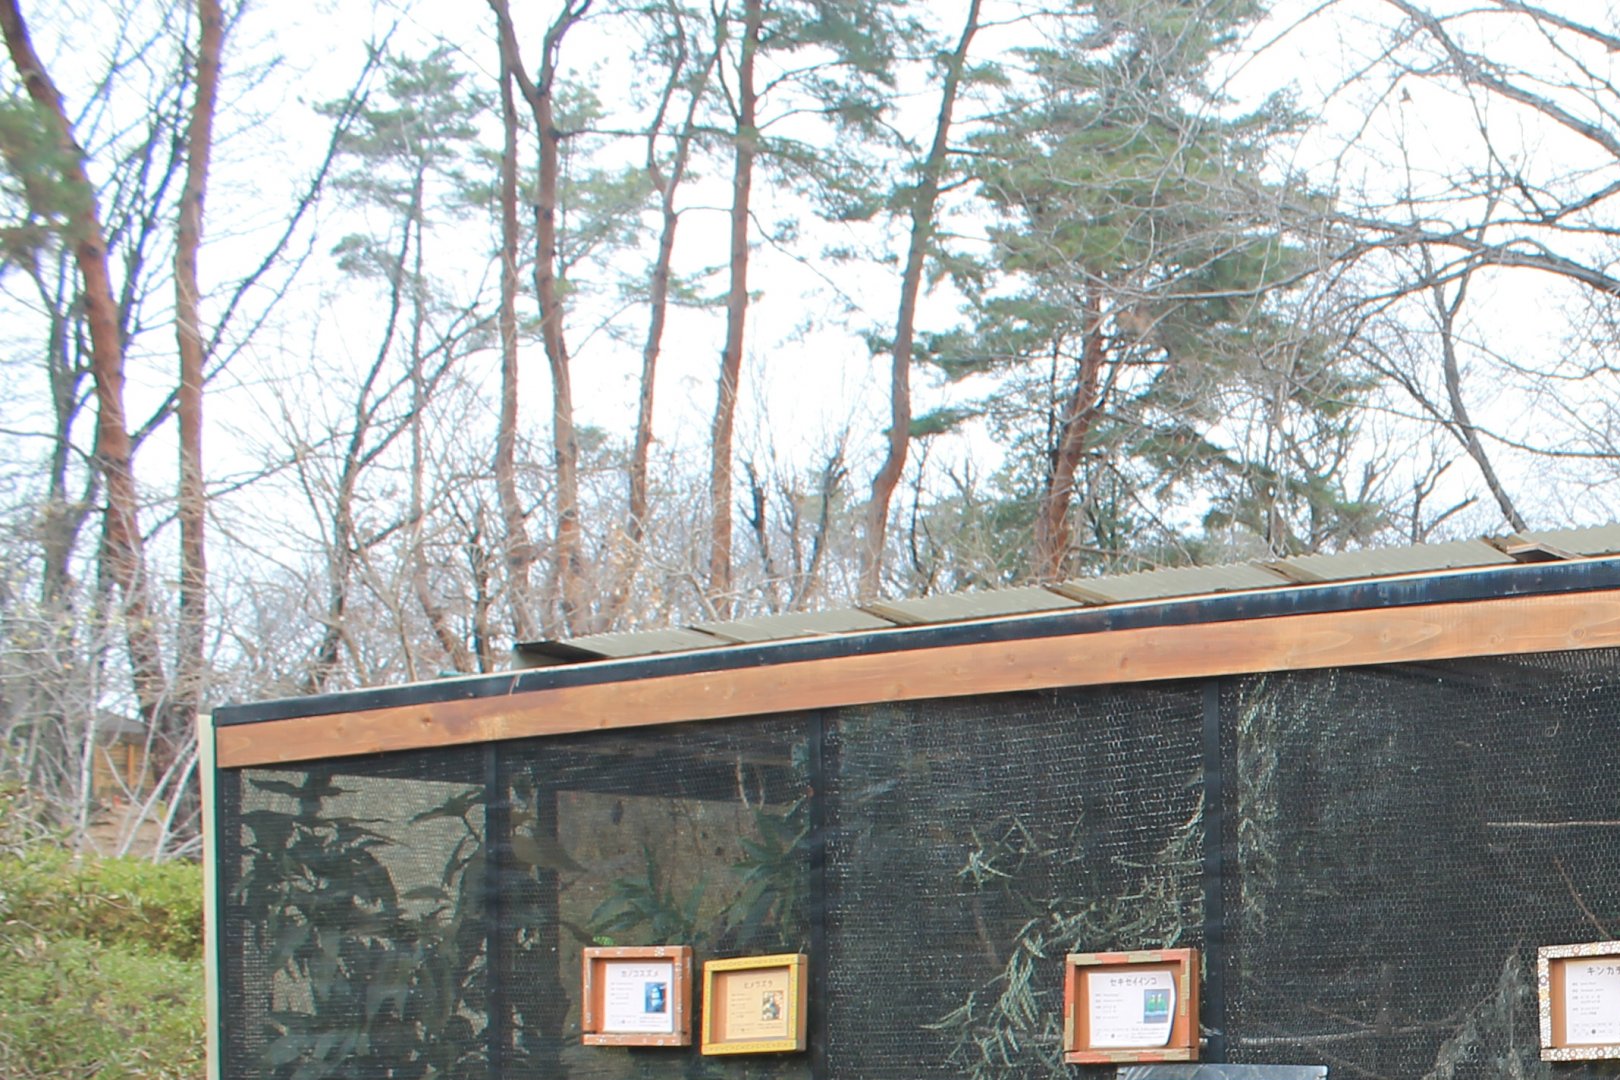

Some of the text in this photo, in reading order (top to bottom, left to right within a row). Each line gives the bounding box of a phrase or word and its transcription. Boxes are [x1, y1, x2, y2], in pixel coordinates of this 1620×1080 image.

[1110, 977, 1158, 987] セキセイインコ
